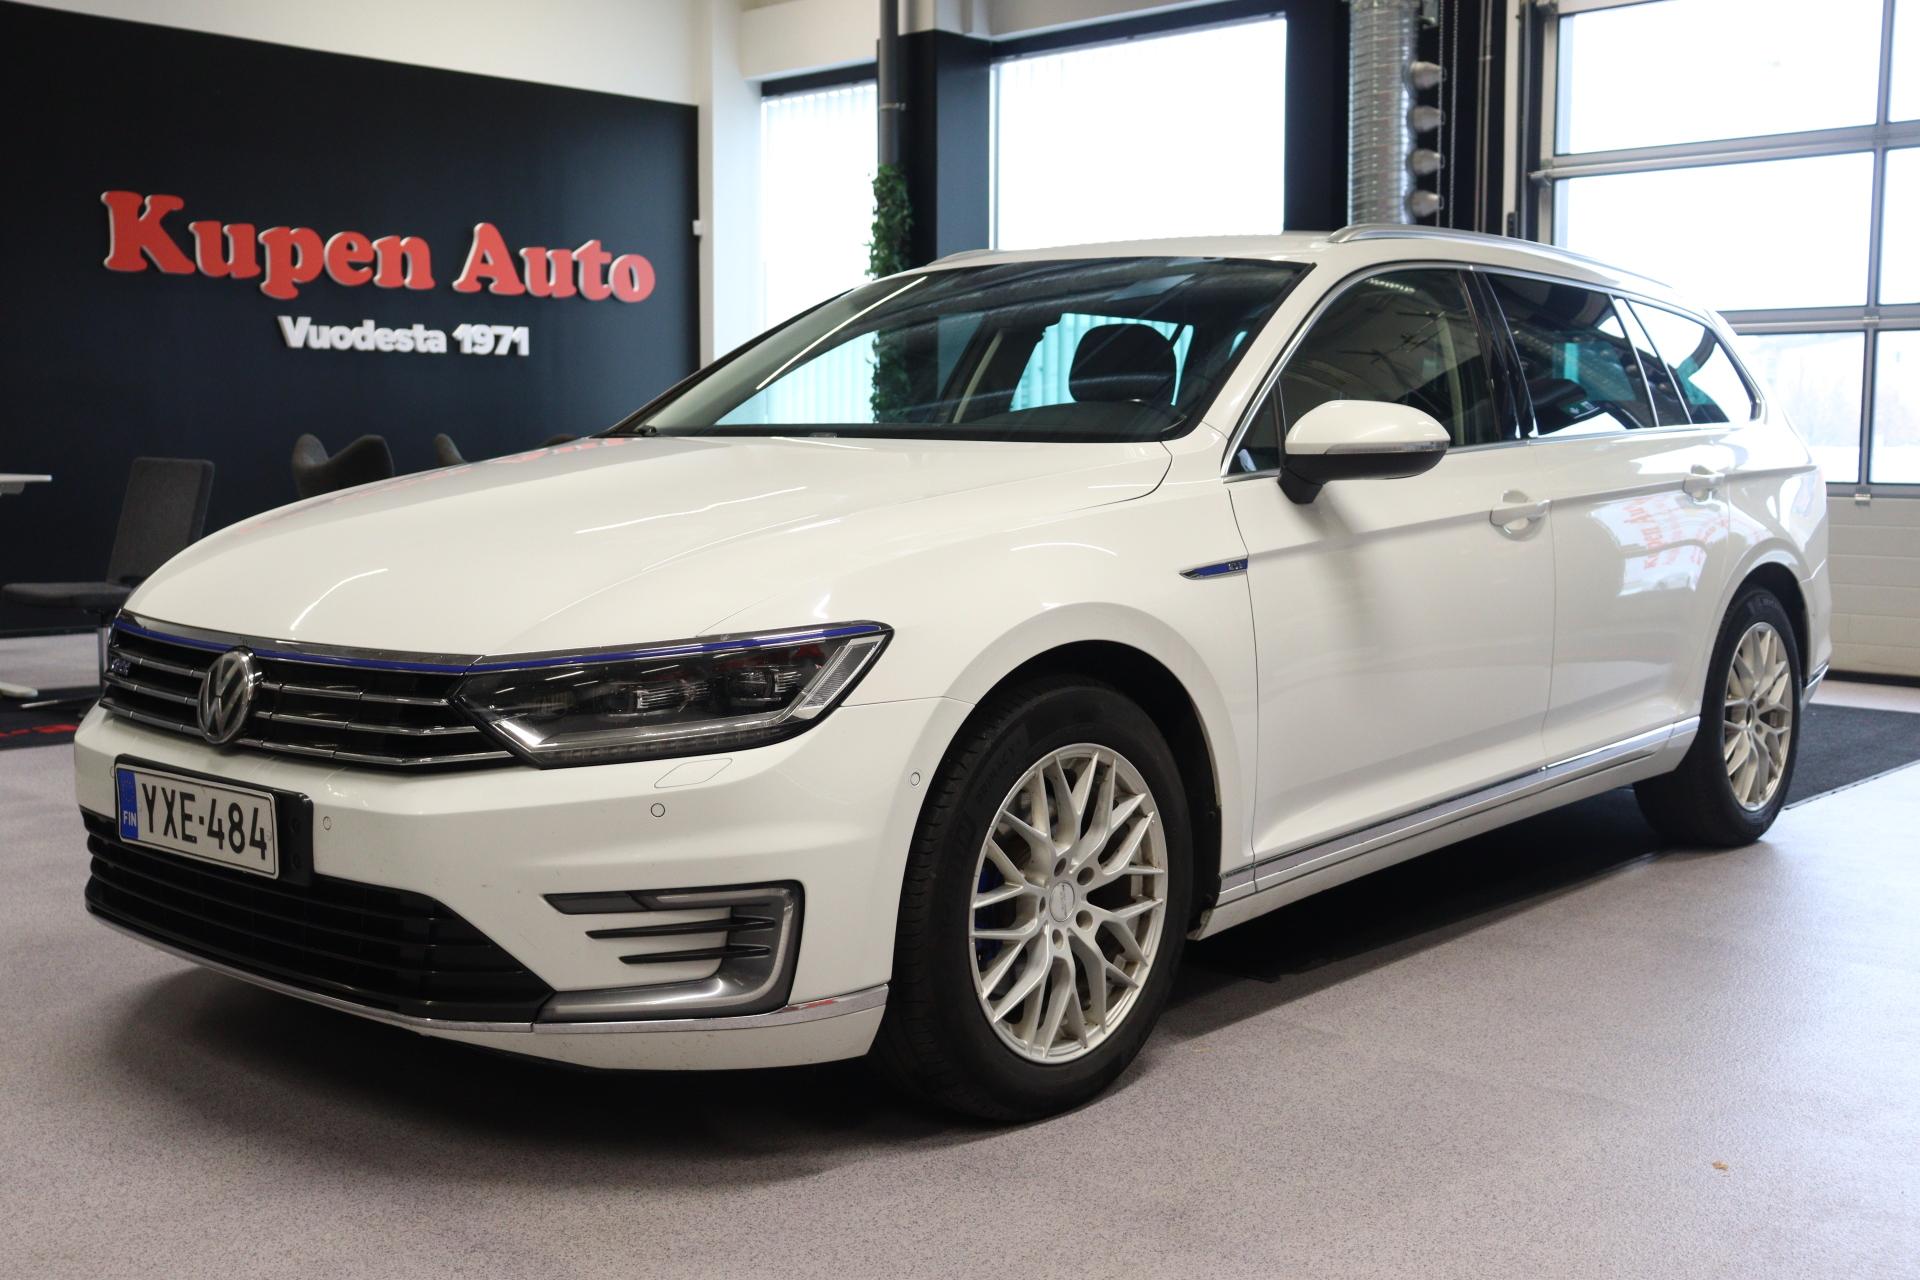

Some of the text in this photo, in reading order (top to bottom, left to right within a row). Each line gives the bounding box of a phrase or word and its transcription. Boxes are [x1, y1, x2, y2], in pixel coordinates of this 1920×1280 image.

[101, 190, 656, 303] Kupen Auto
[277, 315, 530, 356] Vuodesta 1971
[123, 810, 137, 828] FIN
[141, 783, 268, 861] YXE-484
